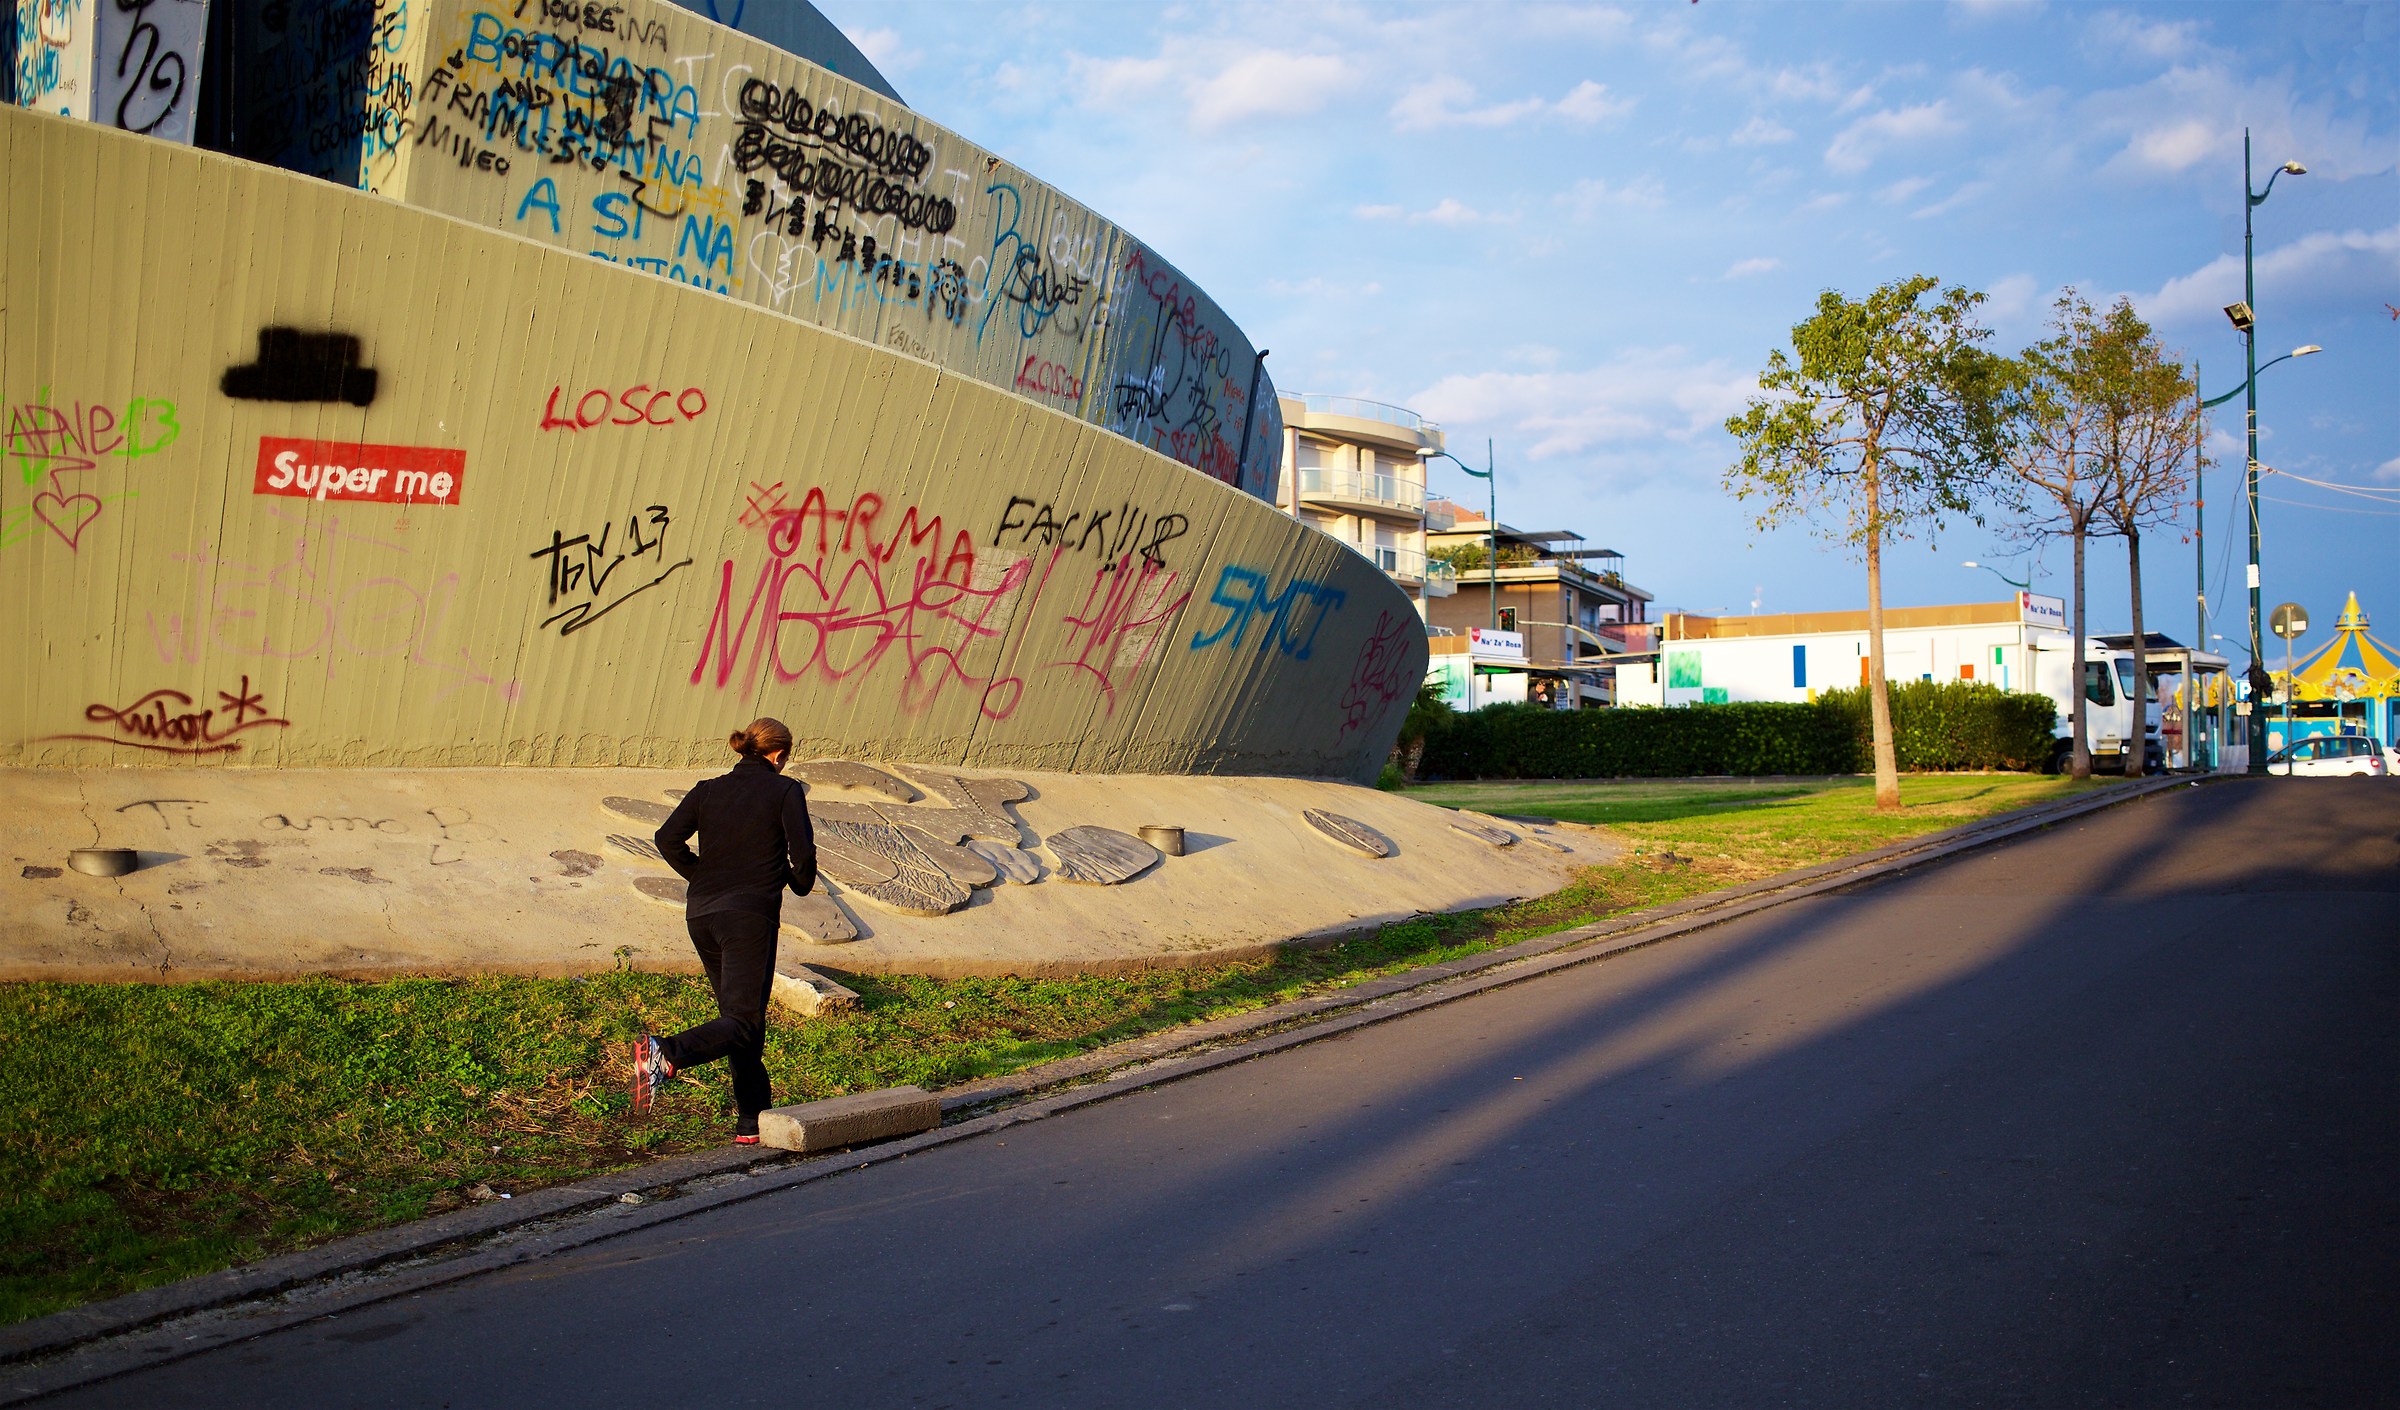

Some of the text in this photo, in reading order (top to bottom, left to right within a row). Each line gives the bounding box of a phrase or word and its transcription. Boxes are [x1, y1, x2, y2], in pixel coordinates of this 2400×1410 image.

[416, 115, 510, 176] MINEO
[541, 384, 708, 433] LOSCO
[267, 451, 454, 509] Super me
[2239, 681, 2252, 700] P
[259, 813, 410, 836] amo
